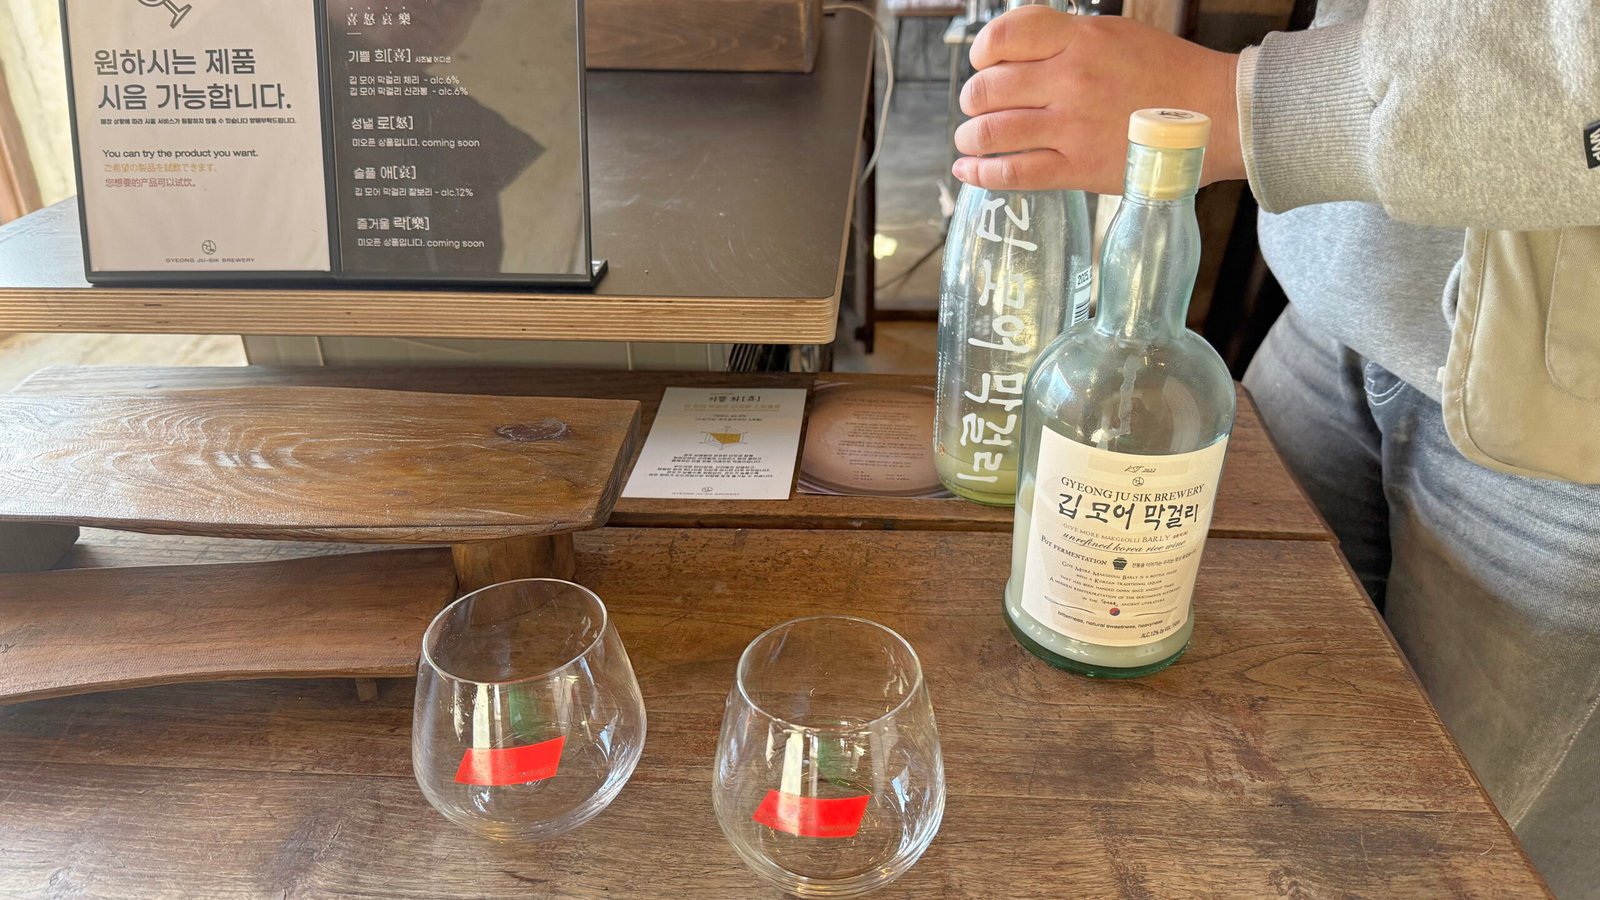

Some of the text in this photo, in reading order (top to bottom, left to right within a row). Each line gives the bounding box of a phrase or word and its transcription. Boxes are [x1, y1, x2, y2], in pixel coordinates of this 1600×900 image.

[94, 48, 256, 75] 원하시는 제품
[348, 50, 371, 62] 기쁠
[360, 76, 375, 85] 모어
[377, 75, 401, 85] 막걸리
[431, 75, 460, 84] alc.6%
[98, 83, 292, 110] 시음 가능합니다.
[360, 87, 375, 95] 모어
[377, 87, 401, 96] 막걸리
[438, 87, 469, 96] alc.6%
[351, 117, 374, 130] 성낼
[352, 138, 376, 147] 미오픈
[378, 138, 420, 147] 상품입니다.
[422, 139, 455, 148] coming
[103, 150, 121, 158] You
[143, 150, 155, 159] try
[175, 149, 211, 158] product
[214, 150, 231, 159] you
[233, 149, 258, 157] want.
[354, 167, 376, 180] 슬플
[105, 178, 195, 188] 您想要的产品可以试饮。
[365, 187, 380, 196] 모어
[383, 187, 406, 196] 막걸리
[441, 187, 474, 197] alc.12%
[357, 218, 390, 230] 즐거울
[358, 238, 381, 247] 미오픈
[383, 238, 425, 247] 상품입니다.
[427, 239, 460, 249] coming
[968, 259, 1029, 353] 모어
[957, 372, 1024, 482] 막걸리
[1061, 476, 1205, 502] GYEONG JU SIK BREWERY
[1086, 502, 1135, 530] 모어
[1145, 504, 1199, 530] 막걸리
[1063, 523, 1077, 532] GIVE
[1080, 529, 1099, 538] MORE
[1102, 535, 1140, 543] MAKGEOLLI
[1142, 534, 1171, 543] BARLY
[1063, 533, 1186, 552] unrefined korea rice wine
[1053, 544, 1107, 565] FERMENTATION
